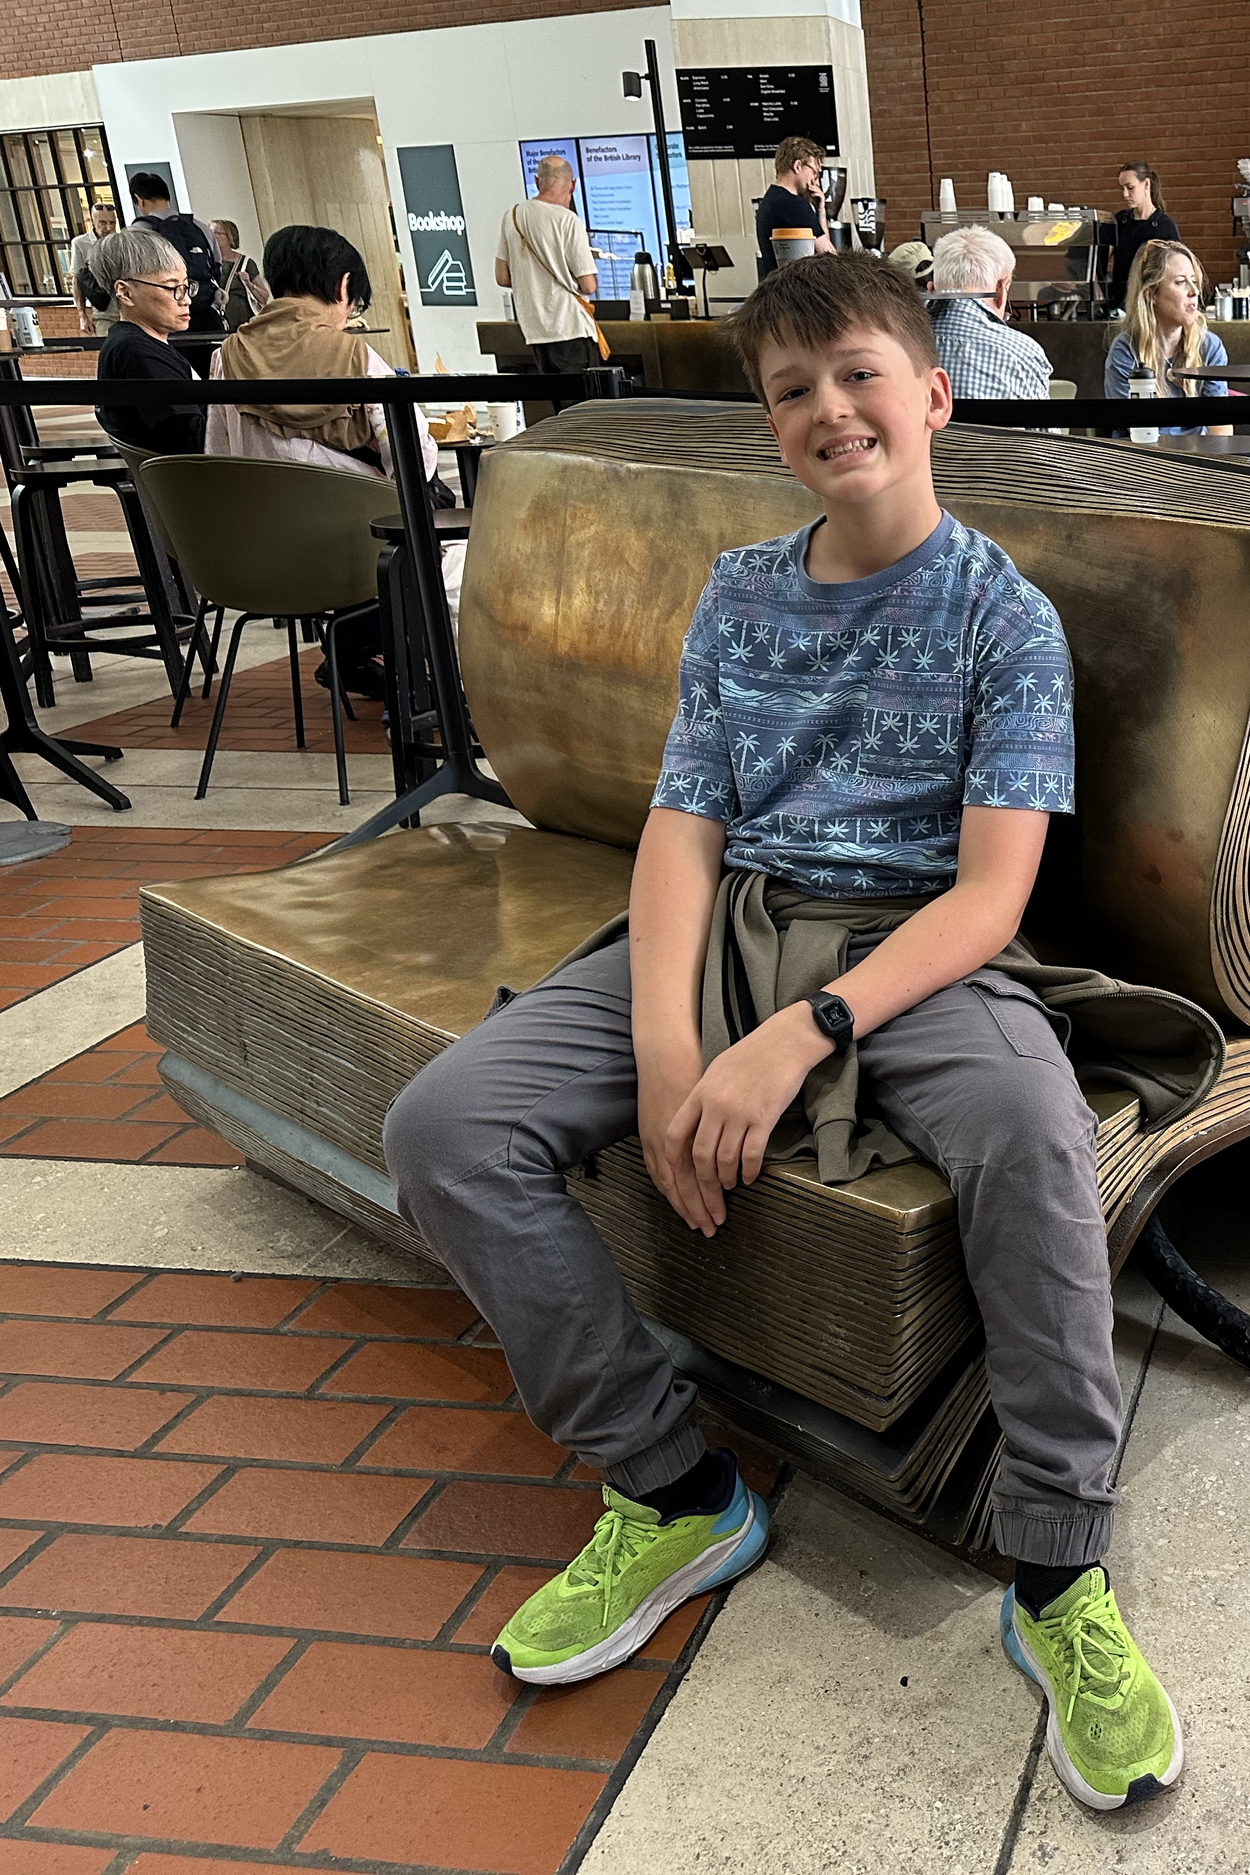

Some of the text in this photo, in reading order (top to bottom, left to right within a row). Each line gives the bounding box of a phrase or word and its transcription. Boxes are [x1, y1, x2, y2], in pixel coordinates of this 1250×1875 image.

[586, 146, 617, 154] Benefactors
[622, 153, 641, 161] Library
[408, 211, 465, 236] Bookshop
